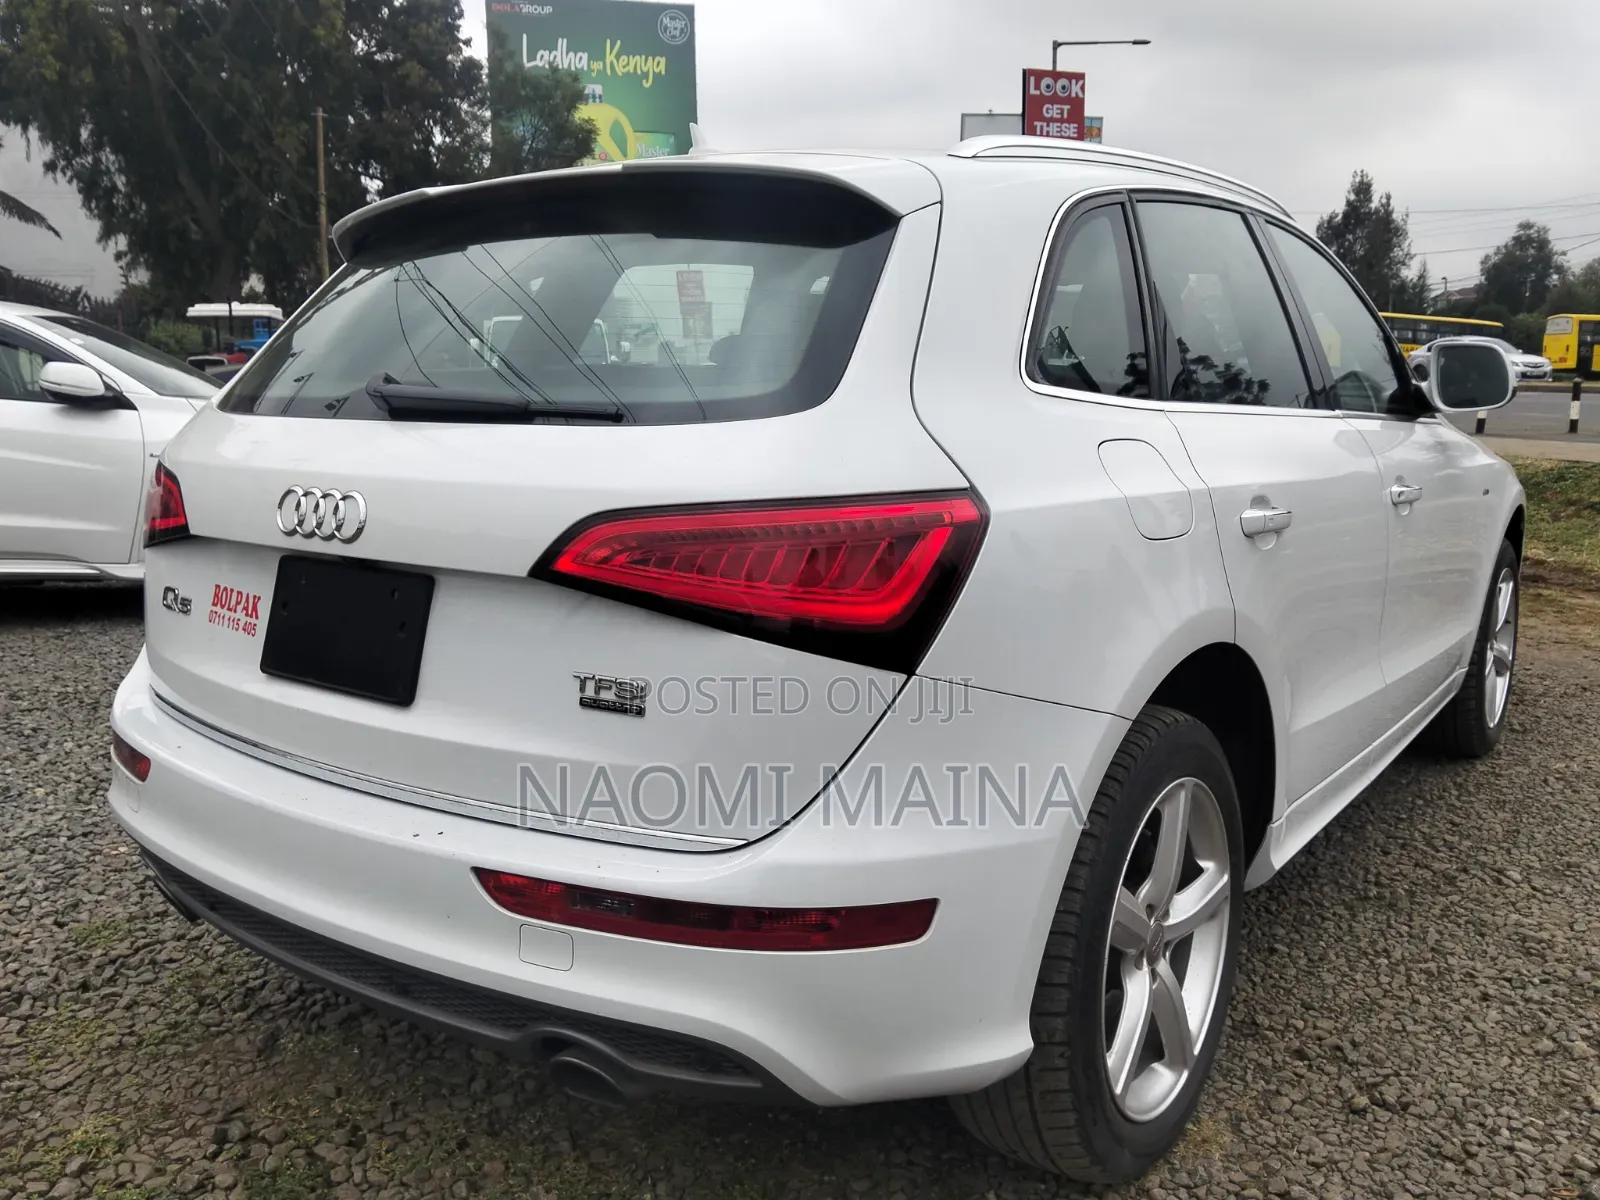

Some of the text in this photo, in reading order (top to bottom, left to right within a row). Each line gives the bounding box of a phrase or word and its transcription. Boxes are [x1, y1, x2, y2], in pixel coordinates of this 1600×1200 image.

[522, 33, 666, 88] Ladha ya Kenya
[1029, 76, 1084, 98] LOOK
[1043, 104, 1070, 118] GET
[1034, 121, 1078, 137] THESE
[636, 143, 671, 157] Master
[162, 586, 192, 616] Q5
[211, 584, 261, 620] BOLPAK
[208, 609, 258, 638] 0711 115 405
[572, 671, 647, 704] TFSI
